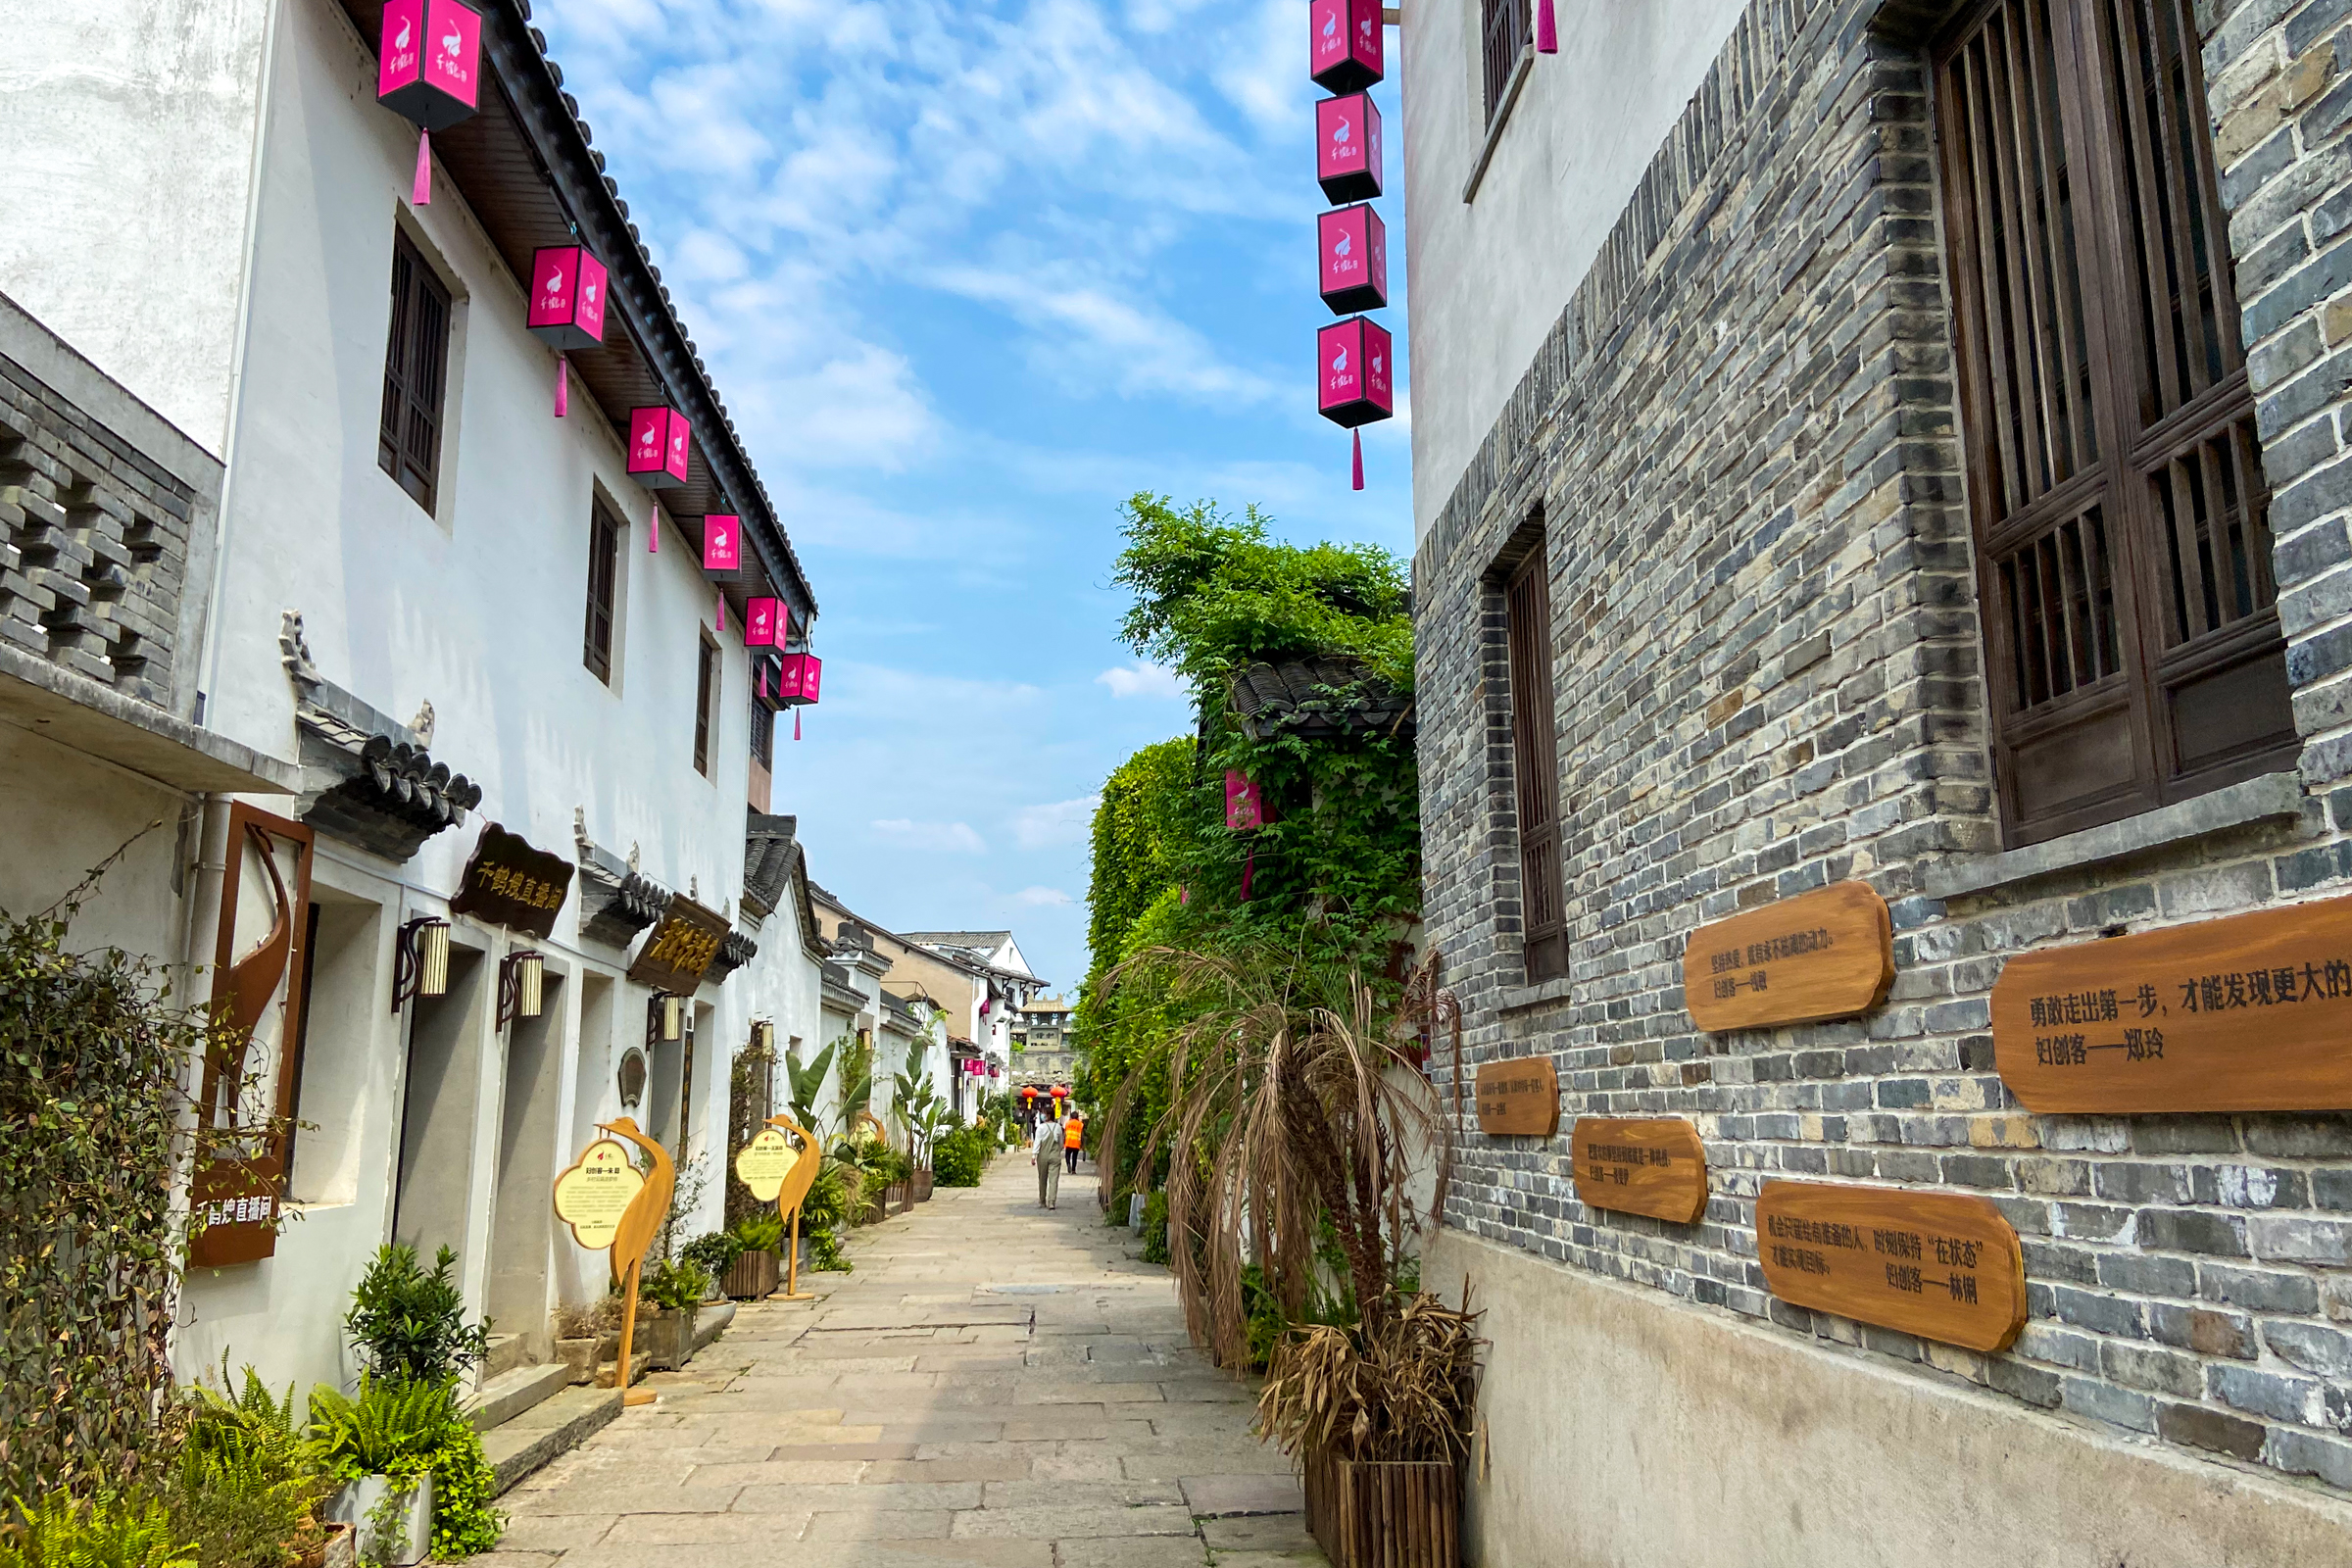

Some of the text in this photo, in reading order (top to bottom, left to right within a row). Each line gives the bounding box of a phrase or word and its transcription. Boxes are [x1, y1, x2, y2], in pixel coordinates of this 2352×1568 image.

[2030, 958, 2352, 1028] 勇敢走出第一步，才能发现更大的
